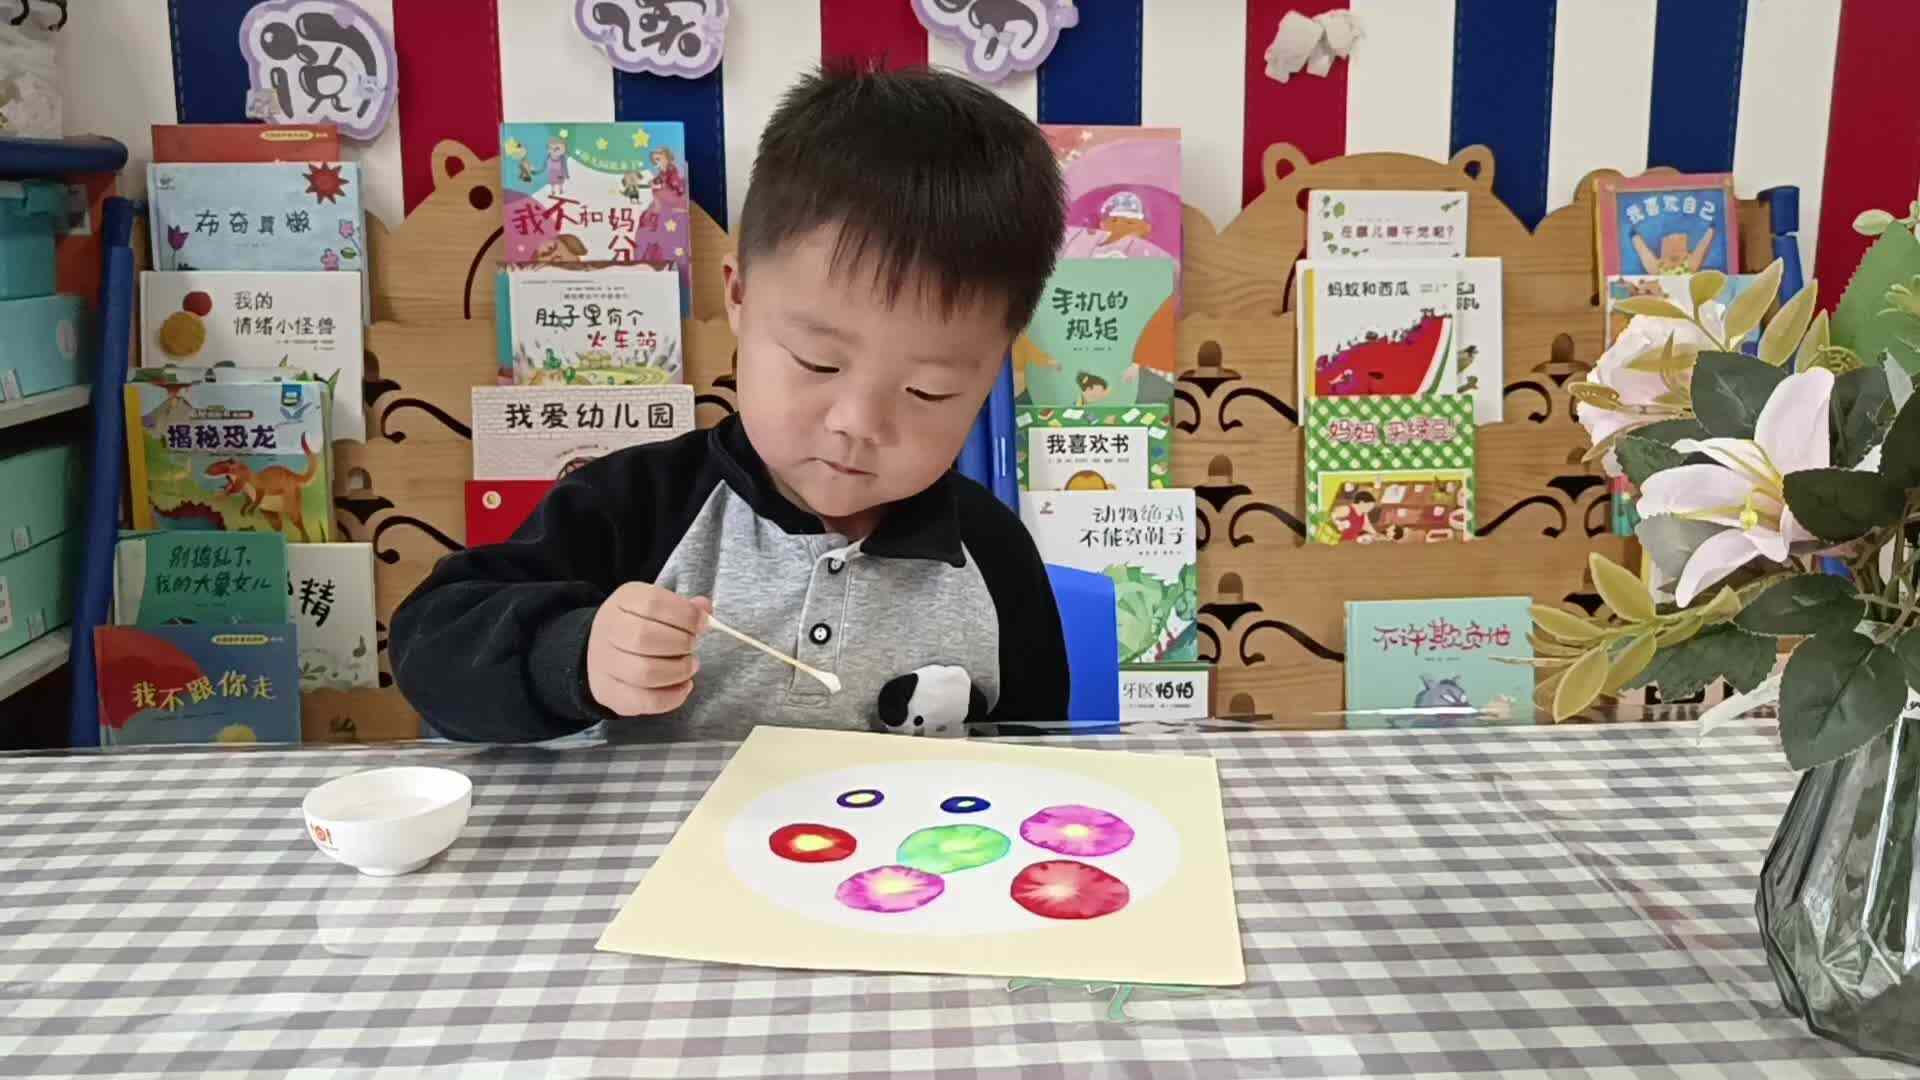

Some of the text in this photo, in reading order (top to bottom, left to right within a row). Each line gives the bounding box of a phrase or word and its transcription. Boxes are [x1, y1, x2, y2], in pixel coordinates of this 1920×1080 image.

[233, 290, 273, 310] 我的
[1052, 287, 1129, 315] 手机的
[1327, 280, 1410, 297] 蚂蚁和西瓜
[233, 316, 336, 336] 情绪小怪兽
[536, 304, 644, 329] 肚子里有个
[1066, 316, 1119, 341] 规矩
[587, 330, 657, 348] 火车站
[505, 403, 674, 429] 我爱幼儿园
[168, 424, 277, 449] 揭秘恐龙
[1047, 433, 1130, 454] 我喜欢书
[131, 670, 276, 712] 我不跟你走
